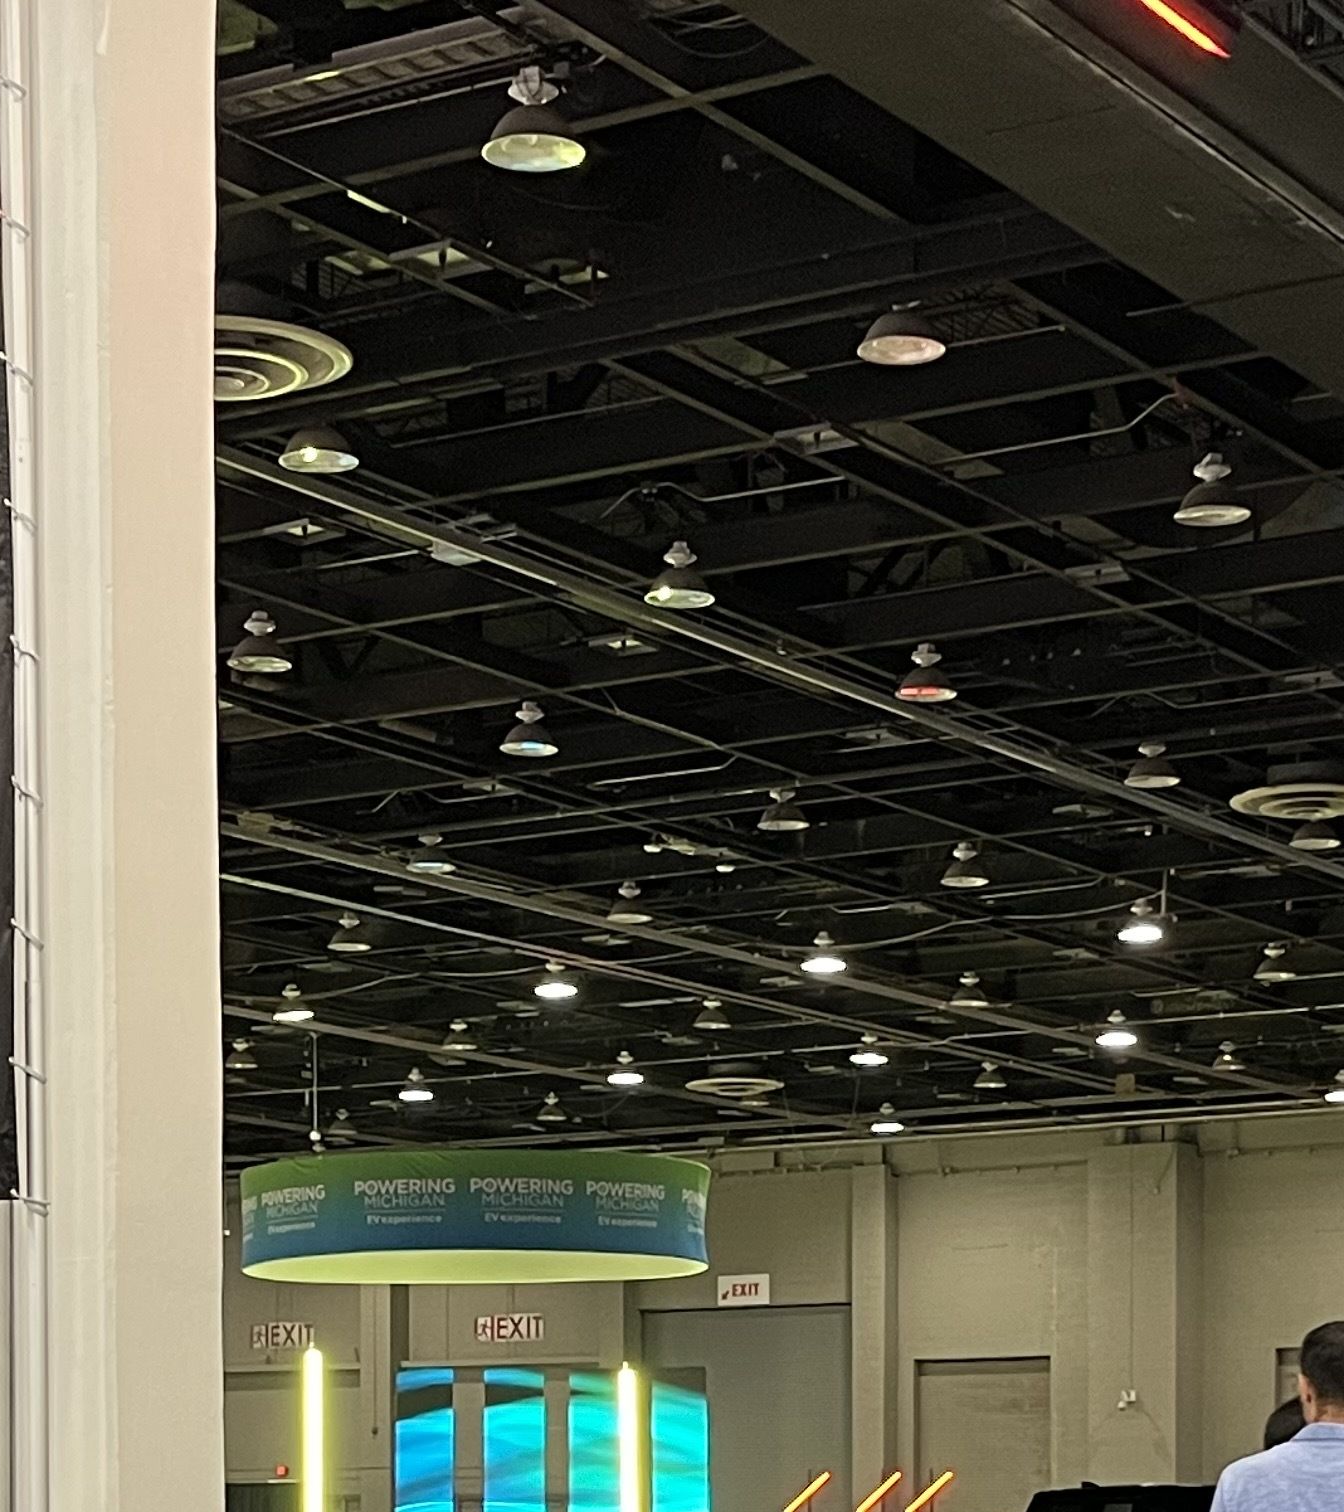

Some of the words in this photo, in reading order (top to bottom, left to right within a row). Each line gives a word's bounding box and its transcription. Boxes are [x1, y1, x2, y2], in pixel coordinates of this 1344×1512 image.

[354, 1178, 456, 1196] POWERING
[470, 1177, 574, 1195] POWERING
[586, 1181, 665, 1200] POWERING
[261, 1184, 325, 1208] POWERING
[364, 1193, 446, 1208] MICHIGAN
[481, 1192, 564, 1207] MICHIGAN
[732, 1283, 759, 1297] EXIT
[271, 1324, 313, 1346] EXIT
[497, 1316, 543, 1339] EXIT
